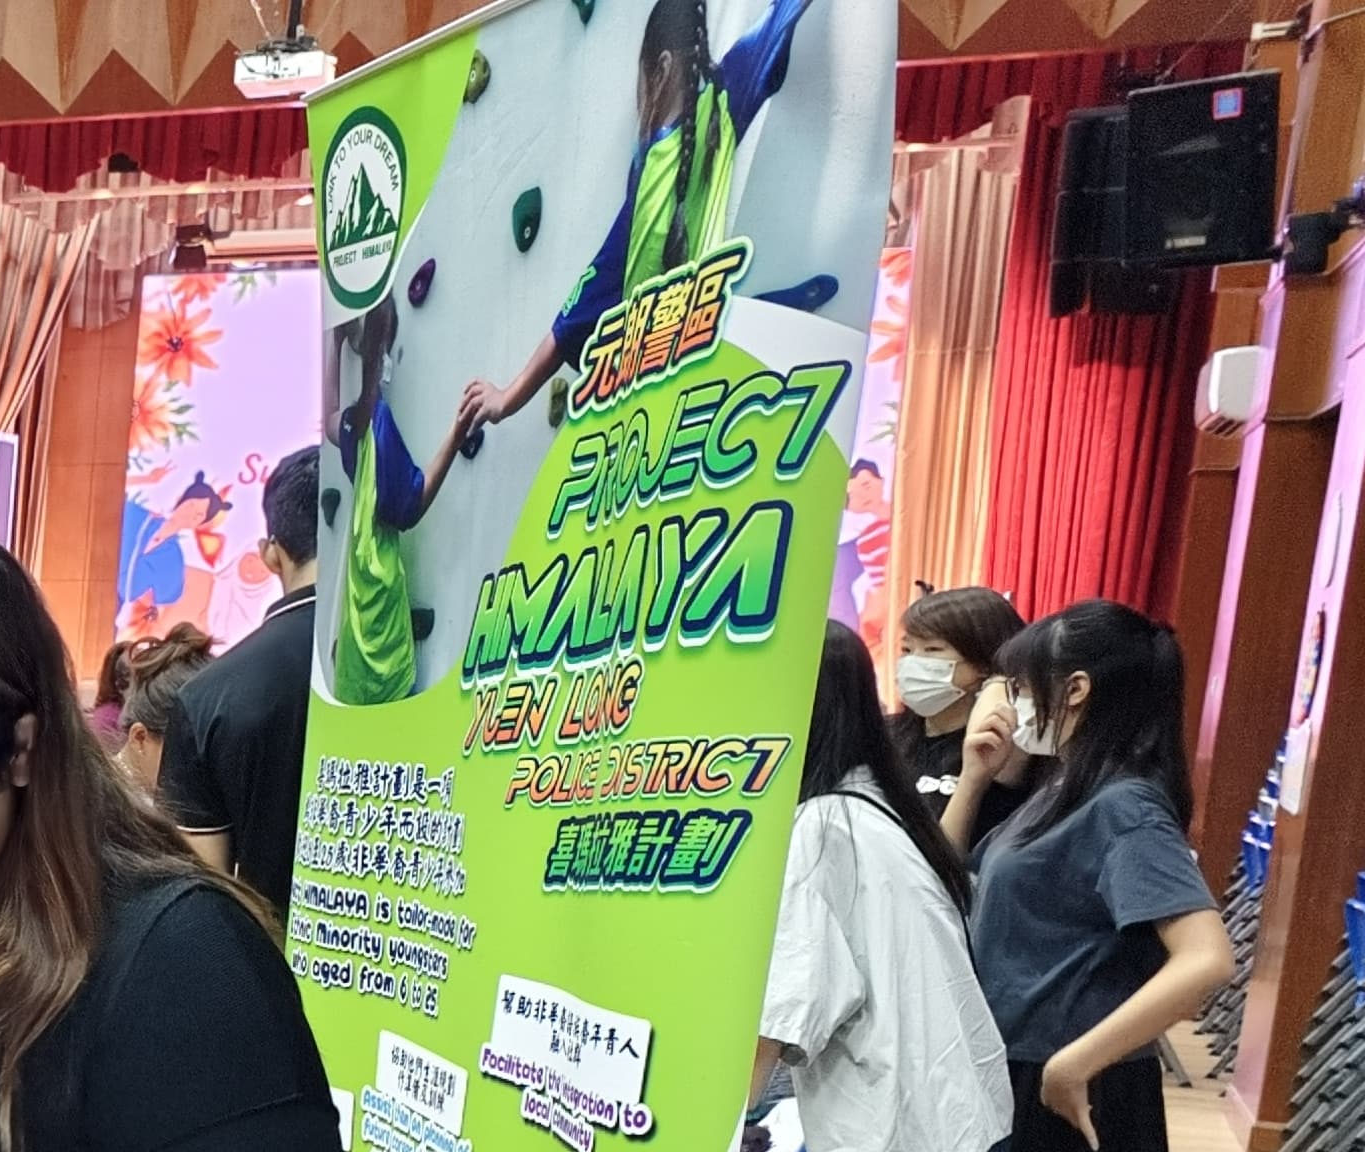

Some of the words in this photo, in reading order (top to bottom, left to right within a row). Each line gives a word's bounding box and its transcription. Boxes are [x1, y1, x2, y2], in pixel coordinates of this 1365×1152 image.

[347, 128, 373, 148] YOUR
[374, 135, 399, 191] DREAM
[572, 247, 747, 408] 元朗警區
[547, 361, 851, 538] PROJECT
[463, 505, 792, 680] HIMALAYA
[465, 677, 557, 750] YUEN
[561, 660, 641, 738] LONG
[506, 755, 601, 806] POLICE
[605, 737, 792, 801] DISTRICT
[376, 893, 390, 920] is
[312, 961, 352, 987] aged
[359, 966, 396, 997] from
[399, 977, 408, 999] 6
[316, 922, 383, 959] Minority
[388, 935, 449, 977] youngsters
[482, 1048, 544, 1085] Facilitate
[624, 1103, 648, 1128] to
[524, 1092, 551, 1120] local
[553, 1109, 592, 1152] community
